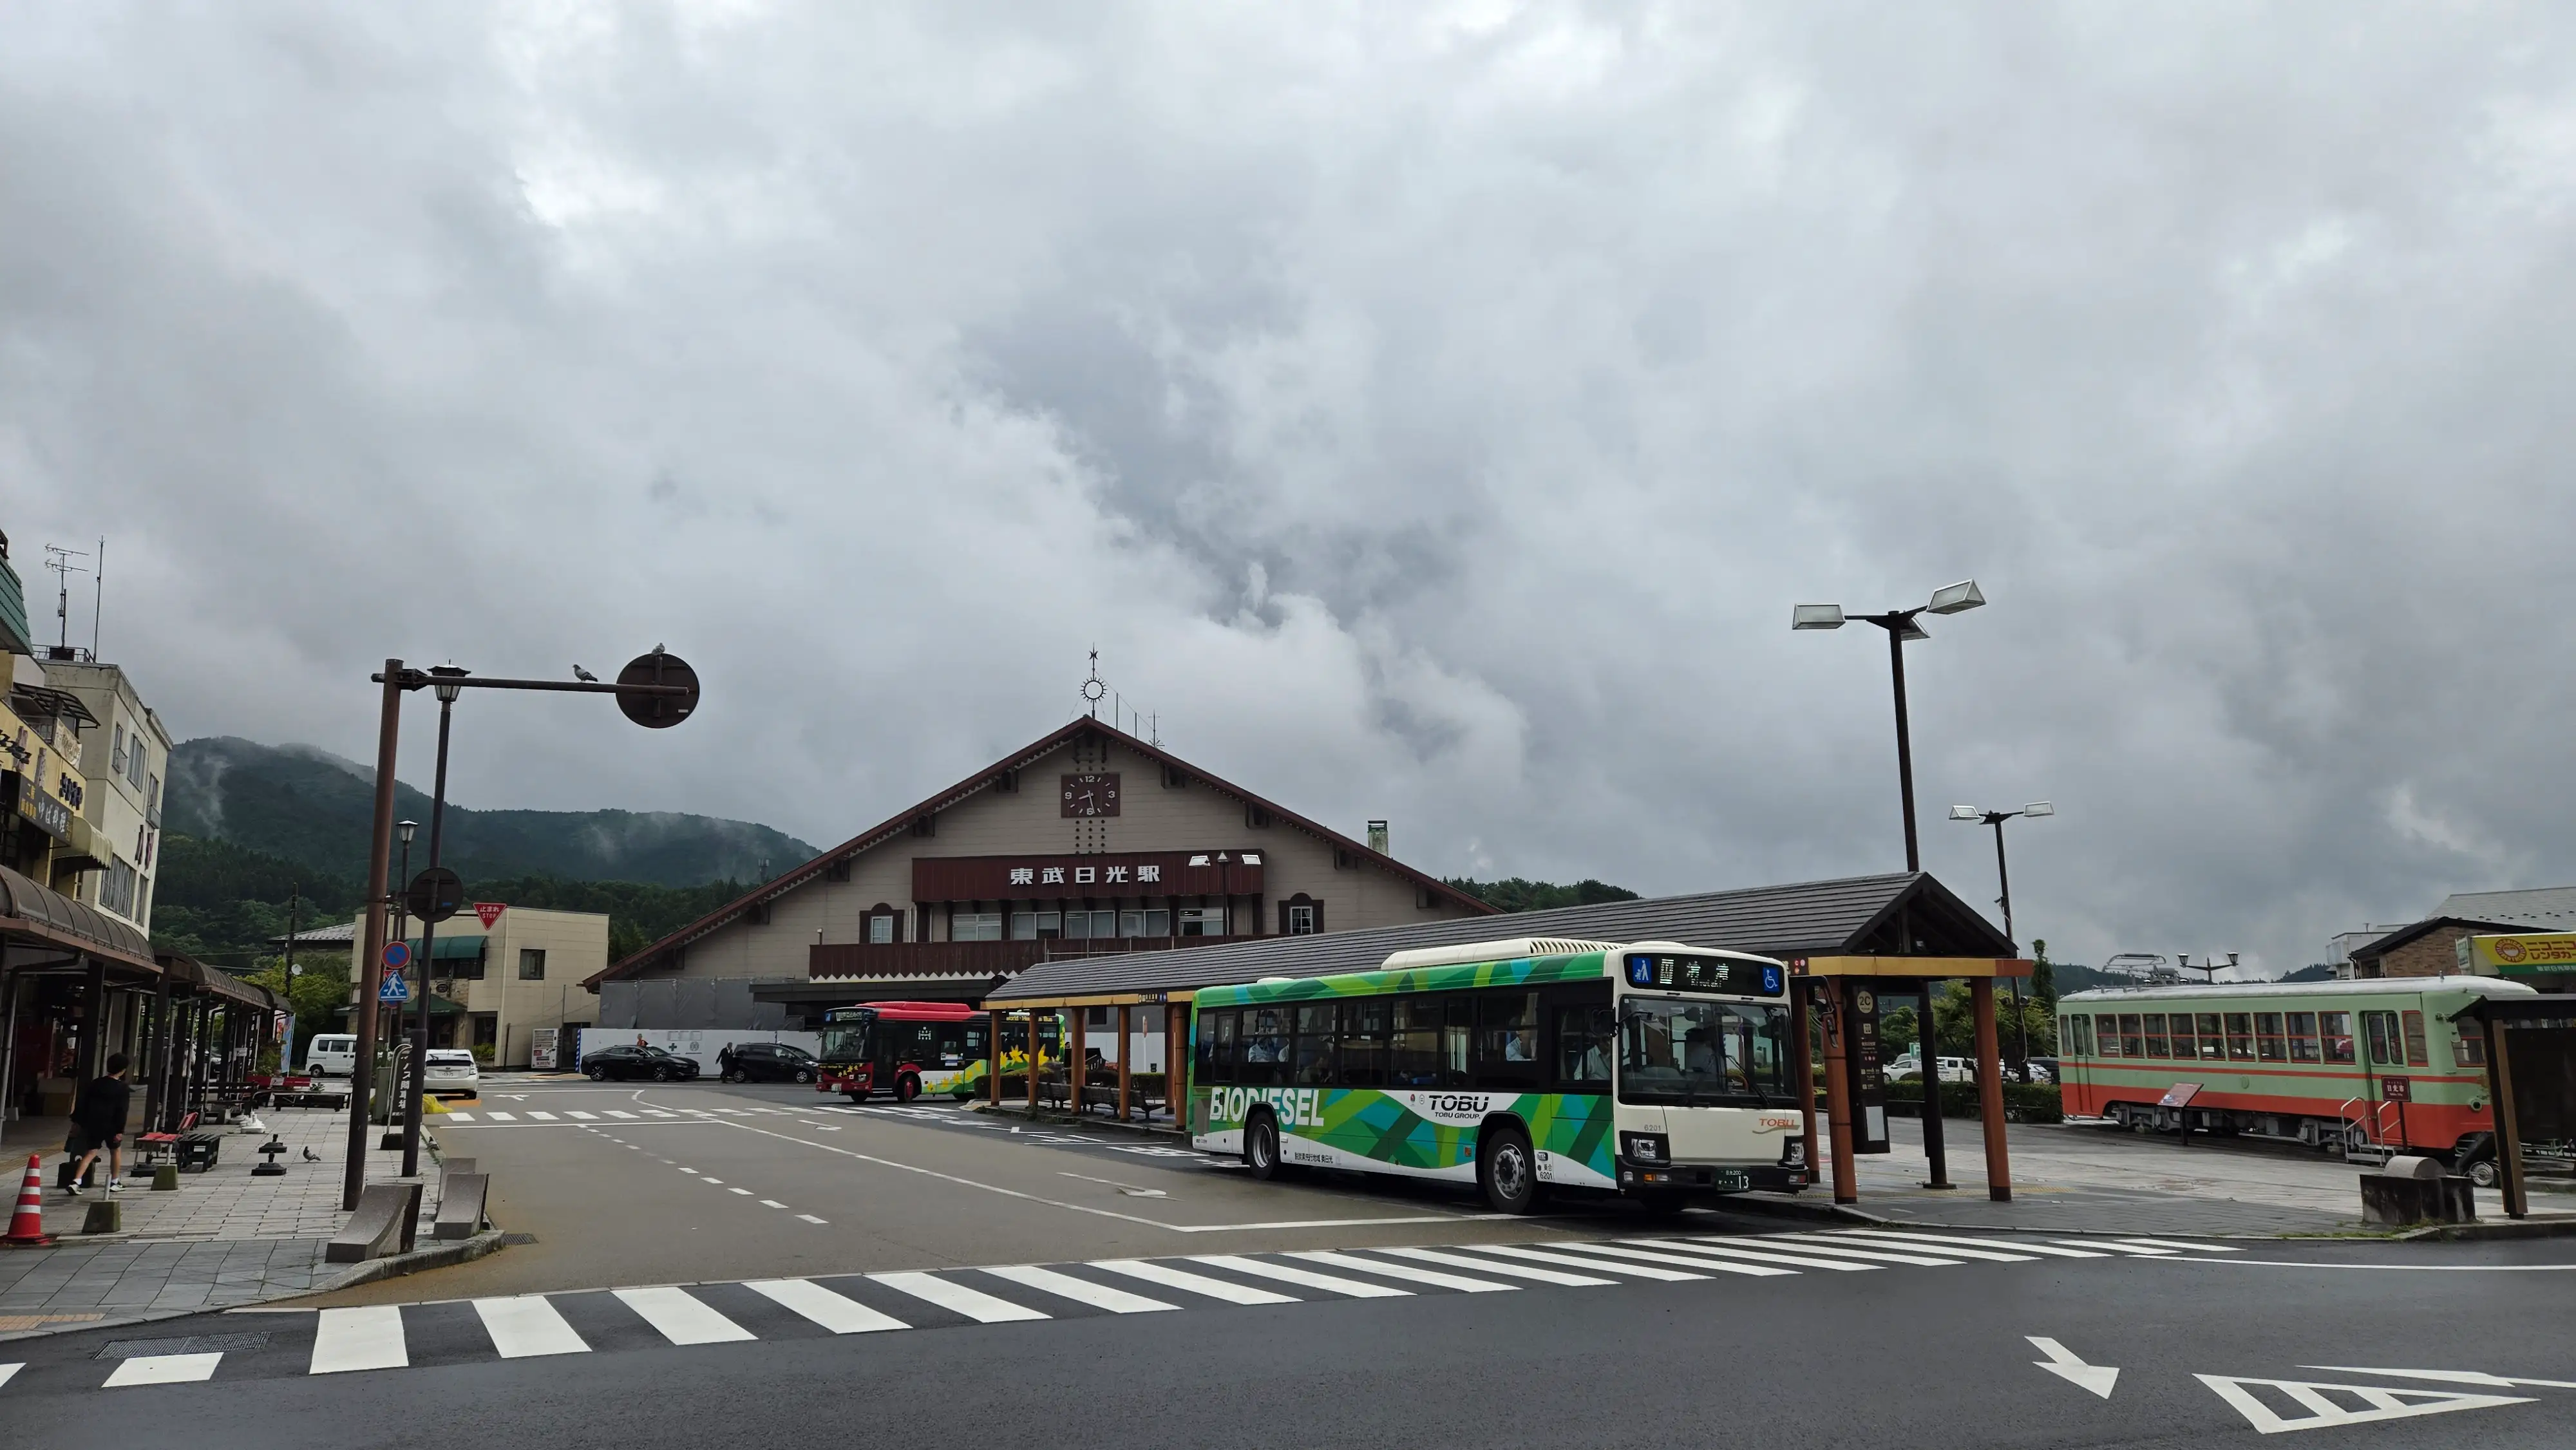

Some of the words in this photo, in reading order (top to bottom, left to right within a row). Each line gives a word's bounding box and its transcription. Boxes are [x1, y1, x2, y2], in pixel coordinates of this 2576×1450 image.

[1065, 791, 1072, 800] 9
[1010, 865, 1160, 885] 東武日光駅
[2526, 940, 2576, 952] ニコニコ
[1859, 996, 1871, 1006] 2C
[1428, 1095, 1490, 1113] TOBU
[1758, 1118, 1795, 1127] TOBU
[1540, 1171, 1553, 1180] 6201
